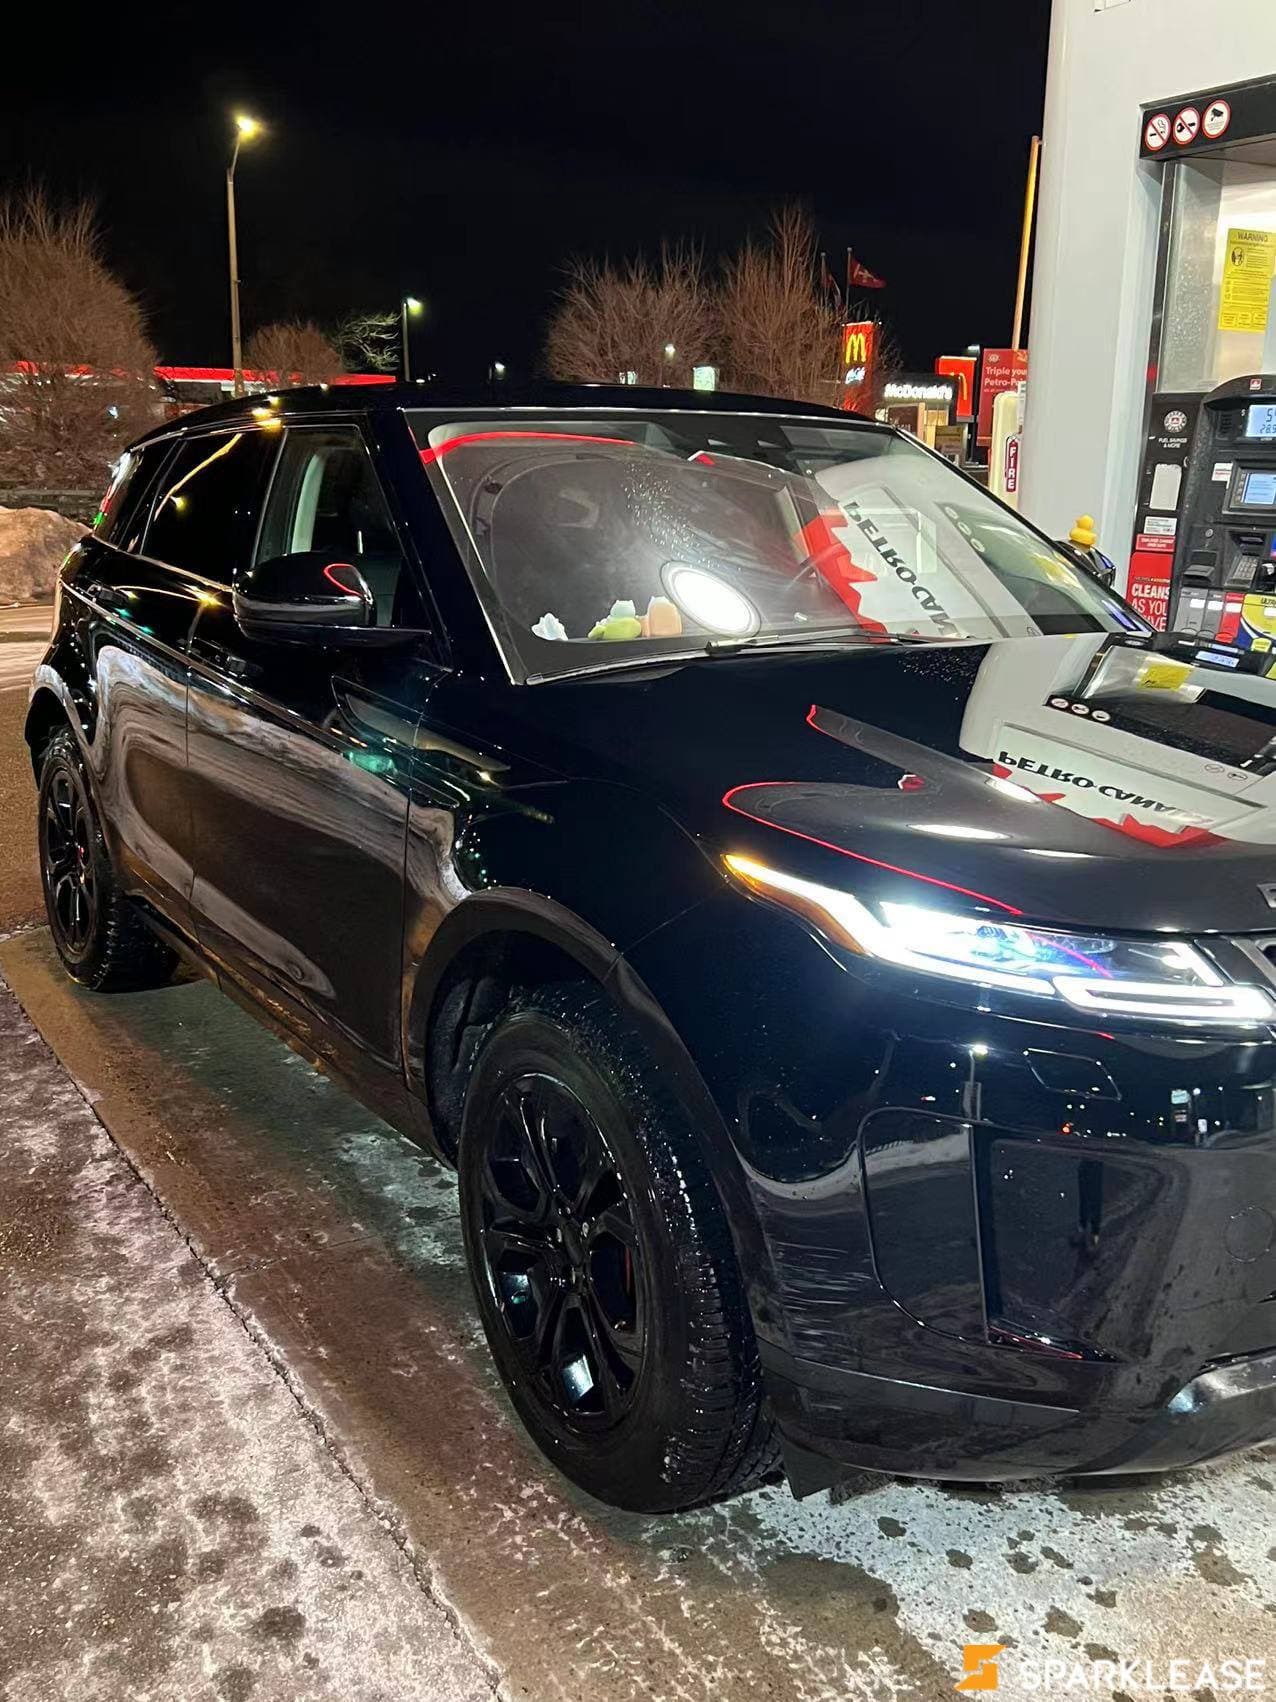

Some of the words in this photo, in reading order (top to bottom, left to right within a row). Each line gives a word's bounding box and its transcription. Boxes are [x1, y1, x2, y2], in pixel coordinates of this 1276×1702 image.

[985, 366, 1010, 377] Triple
[884, 383, 952, 400] McDonald's
[1007, 446, 1018, 489] FIRE
